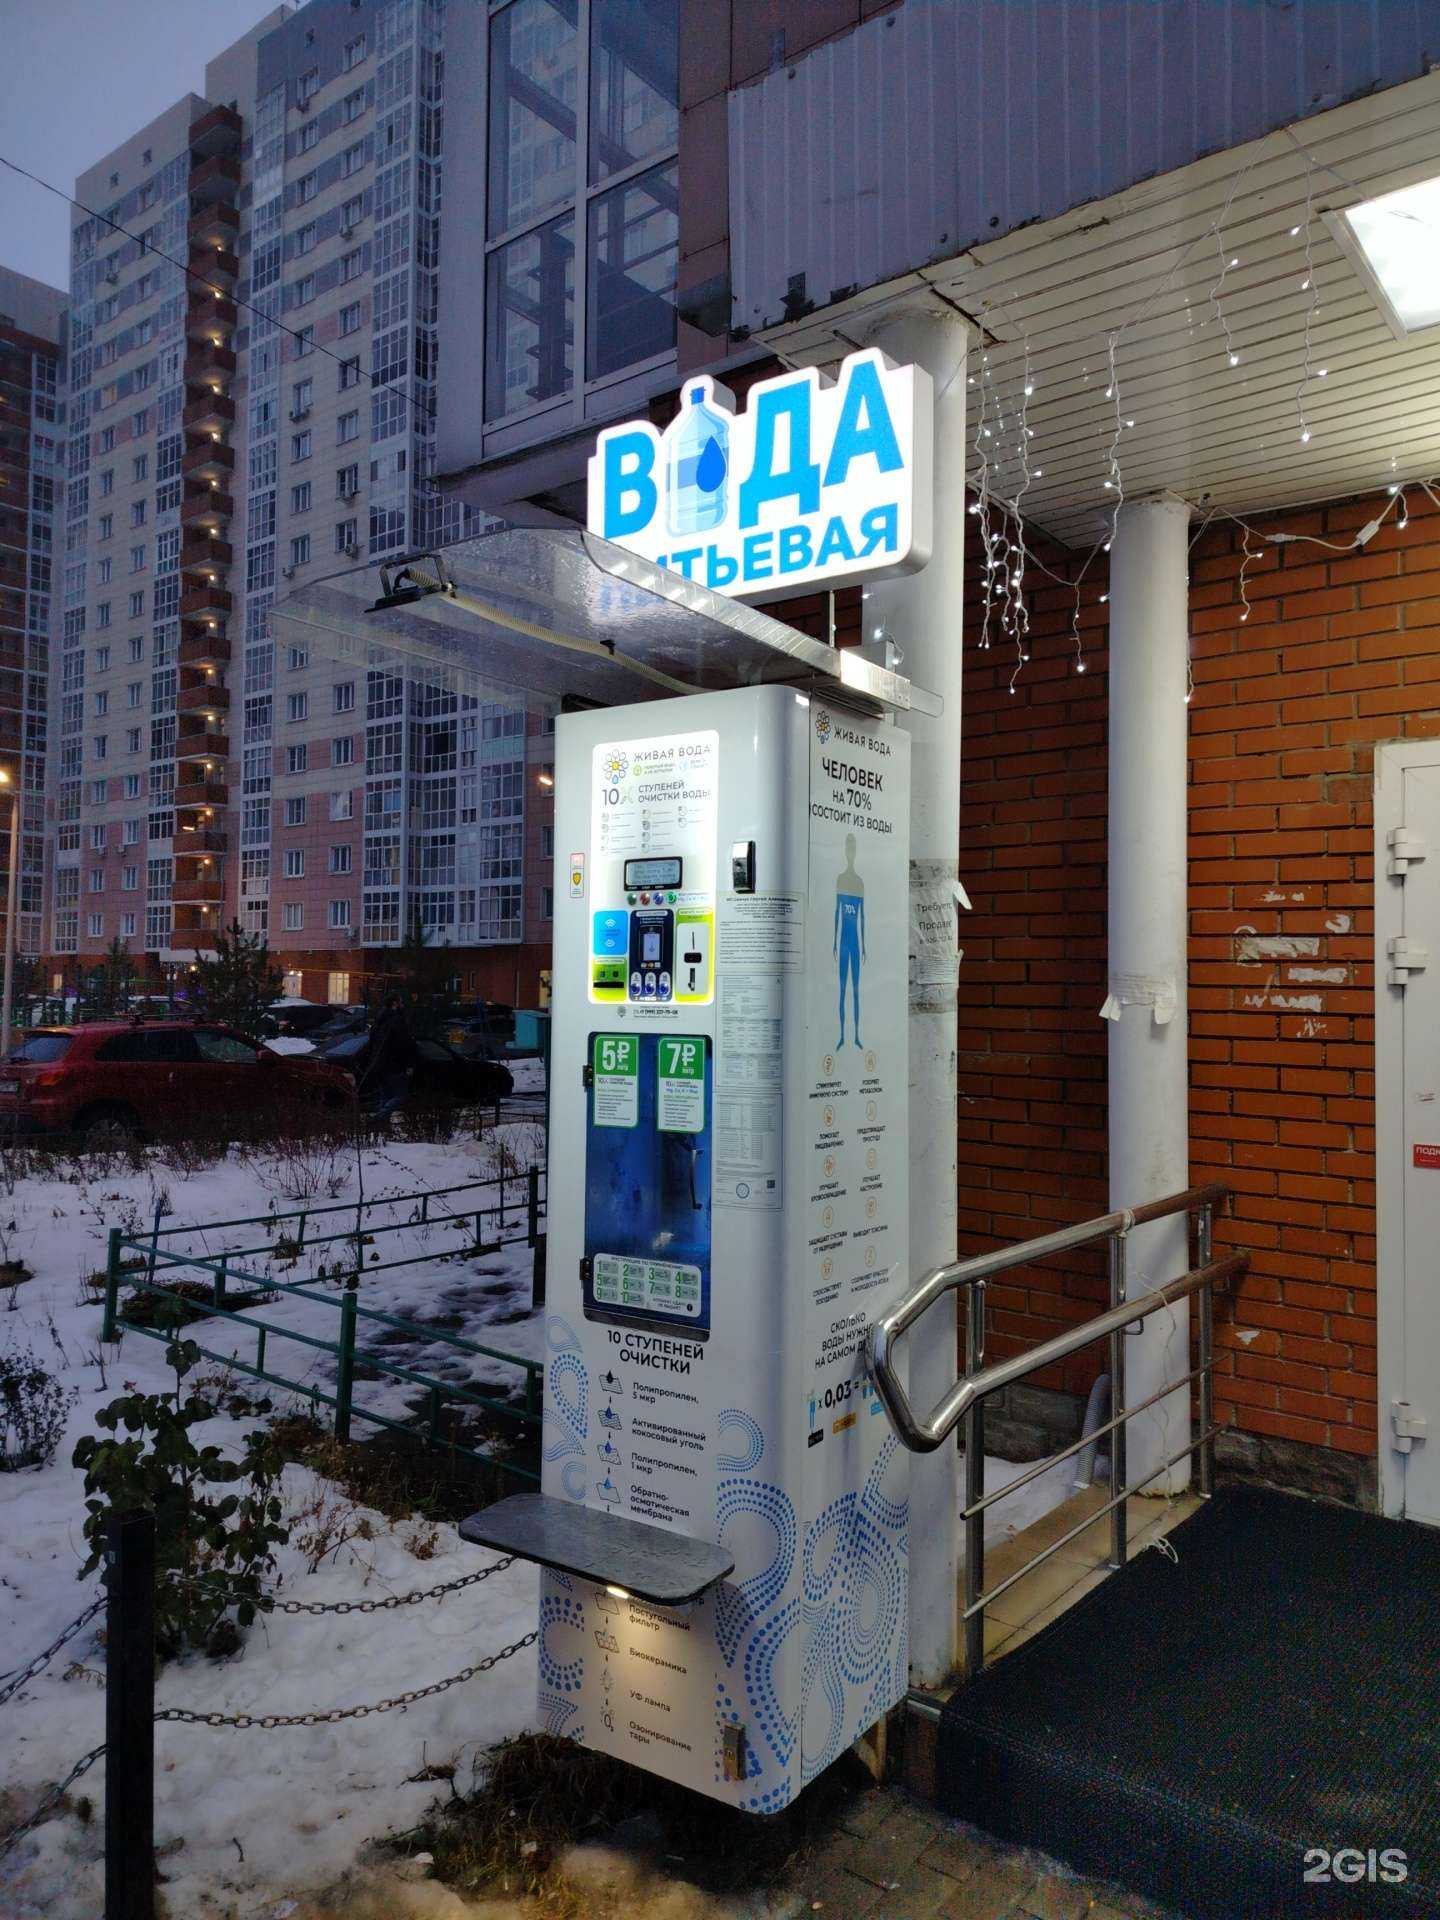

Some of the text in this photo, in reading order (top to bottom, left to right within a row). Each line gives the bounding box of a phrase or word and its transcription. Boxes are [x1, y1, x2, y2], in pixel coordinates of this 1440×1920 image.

[655, 502, 898, 589] ТЬЕВАЯ
[834, 726, 892, 757] ЖИВАЯ ВОДА
[634, 745, 711, 762] ЖИВАЯ ВОДА
[822, 757, 883, 792] ЧЕЛОВЕК
[602, 788, 619, 806] 10
[638, 780, 685, 793] СТУПЕНЕЙ
[638, 790, 711, 803] ОЧИСТКИ ВОДЫ
[832, 788, 872, 811] НА 70%
[811, 802, 893, 834] СОСТОИТ ИЗ ВОДЫ
[831, 1312, 866, 1333] СКОЛЬКО
[608, 1330, 704, 1361] 10 СТУПЕНЕЙ
[822, 1333, 845, 1351] ВОДЫ
[619, 1348, 691, 1375] ОЧИСТКИ
[815, 1356, 826, 1369] НА
[827, 1344, 856, 1364] САМОМ
[632, 1382, 699, 1405] Полипропилен,
[639, 1394, 656, 1405] мкр
[825, 1380, 852, 1409] 0,03
[632, 1418, 706, 1442] Активированный
[632, 1427, 704, 1451] кокосовый уголь
[631, 1452, 698, 1477] Полипропилен,
[636, 1464, 653, 1475] мкр
[630, 1484, 669, 1501] Обратно-
[630, 1495, 690, 1517] осмотическая
[630, 1504, 673, 1523] мембрана
[629, 1603, 691, 1631] Постугольный
[629, 1614, 660, 1631] фильтр
[629, 1647, 688, 1675] Биокерамика
[630, 1690, 671, 1713] УФ лампа
[629, 1720, 692, 1752] Озонирование
[629, 1732, 650, 1745] тары
